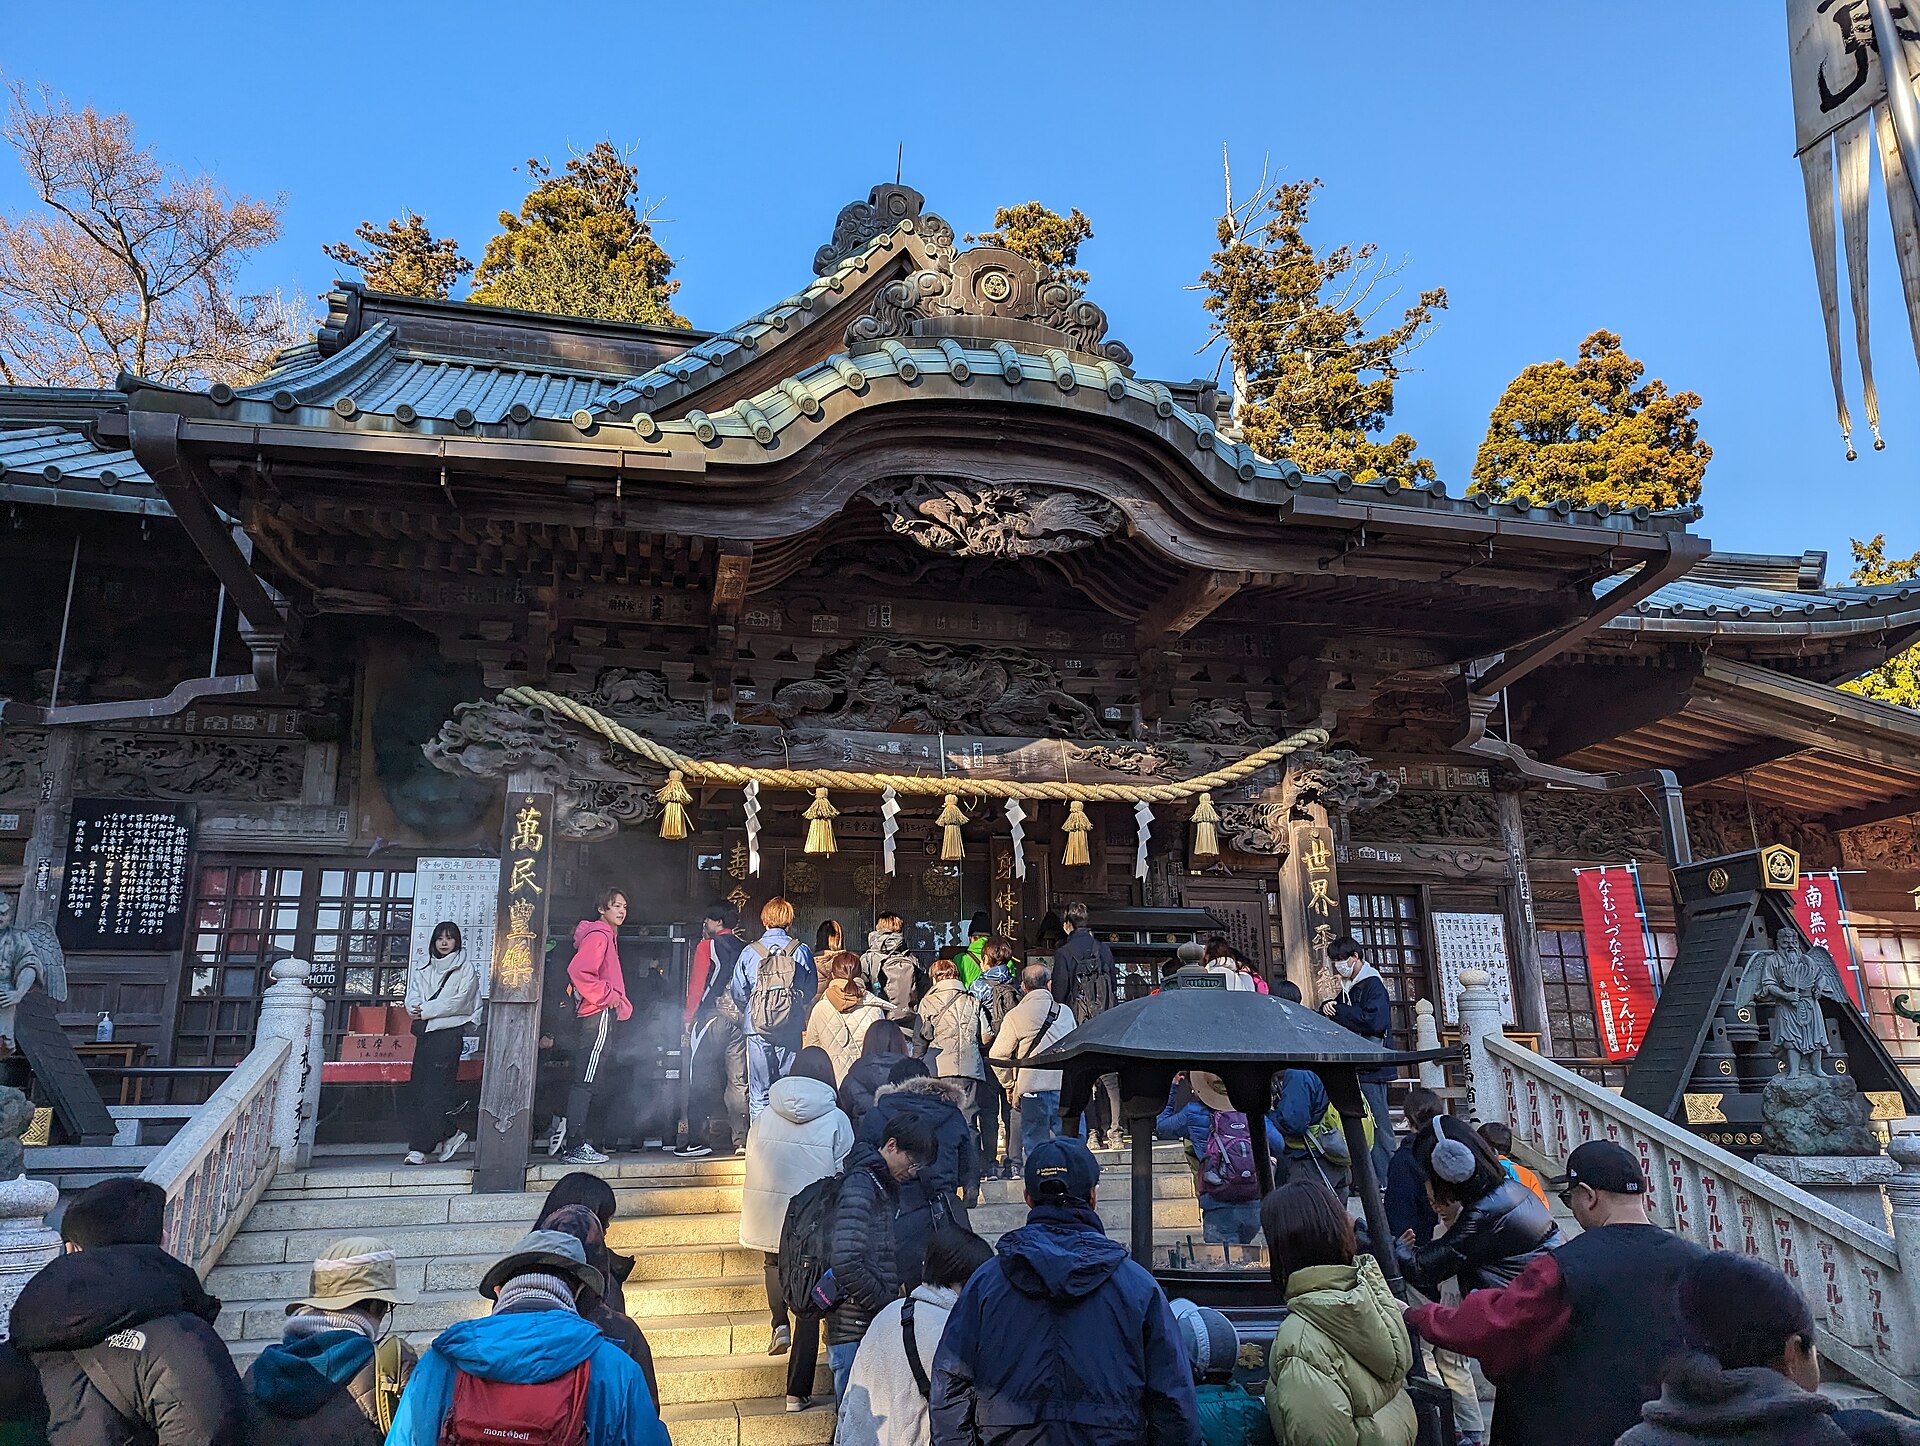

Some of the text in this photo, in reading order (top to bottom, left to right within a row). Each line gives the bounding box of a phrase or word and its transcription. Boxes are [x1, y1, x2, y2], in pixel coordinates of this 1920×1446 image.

[303, 974, 335, 985] PHOTO
[1491, 924, 1510, 1005] 高尾山行事
[1598, 878, 1640, 1053] なむいづなだいごんげん
[357, 1038, 403, 1050] 護摩木
[1503, 1067, 1517, 1128] ヤクルト
[1526, 1080, 1541, 1143] ヤクルト
[1551, 1093, 1568, 1159] ヤクルト
[220, 1131, 235, 1217] ヤクルト
[1668, 1158, 1689, 1232] ヤクルト
[1702, 1176, 1724, 1252] ヤクルト
[1817, 1239, 1844, 1333] ヤクルト
[1861, 1266, 1891, 1356] ヤクルト
[108, 1340, 131, 1349] FACE
